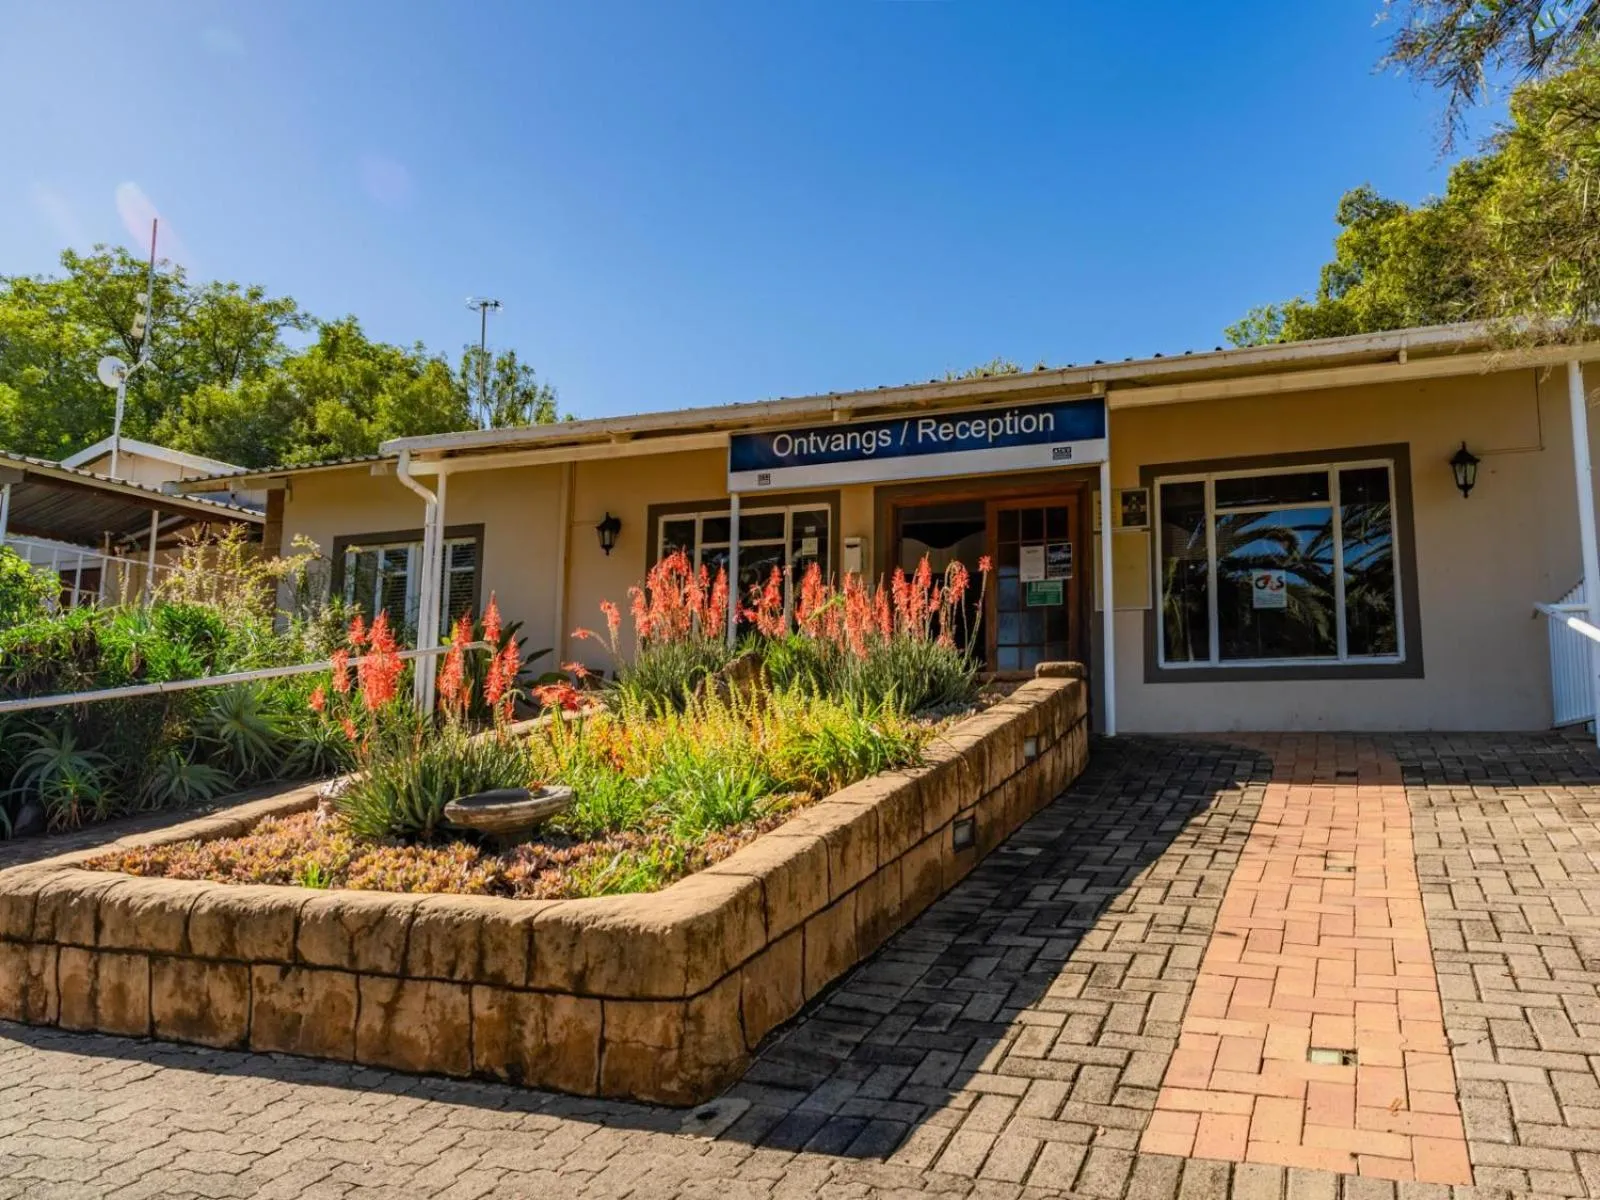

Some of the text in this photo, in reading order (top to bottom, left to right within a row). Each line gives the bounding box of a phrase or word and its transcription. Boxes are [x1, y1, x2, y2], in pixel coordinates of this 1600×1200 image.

[772, 410, 1055, 458] Ontvangs / Reception
